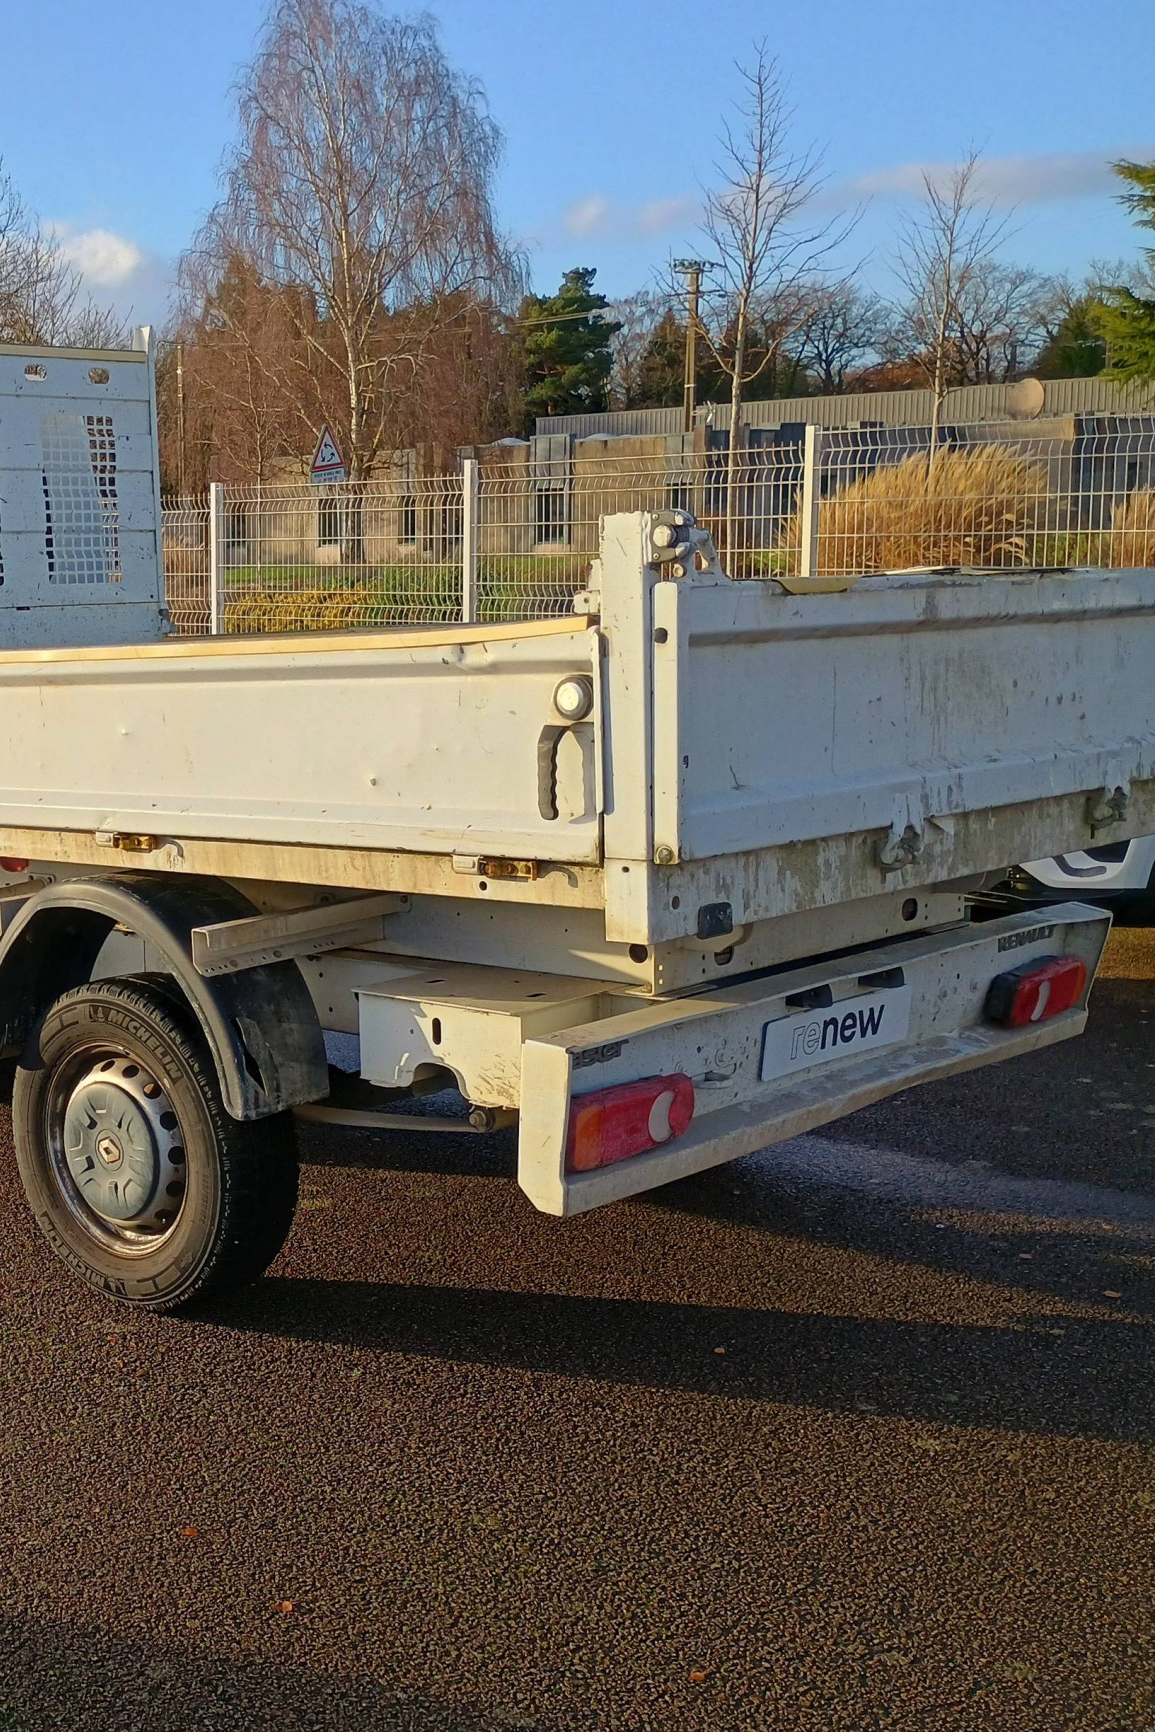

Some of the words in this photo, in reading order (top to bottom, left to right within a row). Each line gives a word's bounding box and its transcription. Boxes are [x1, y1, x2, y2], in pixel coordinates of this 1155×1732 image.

[997, 924, 1057, 953] RENAULT
[107, 1009, 185, 1083] MICHELIN
[790, 1004, 885, 1060] renew
